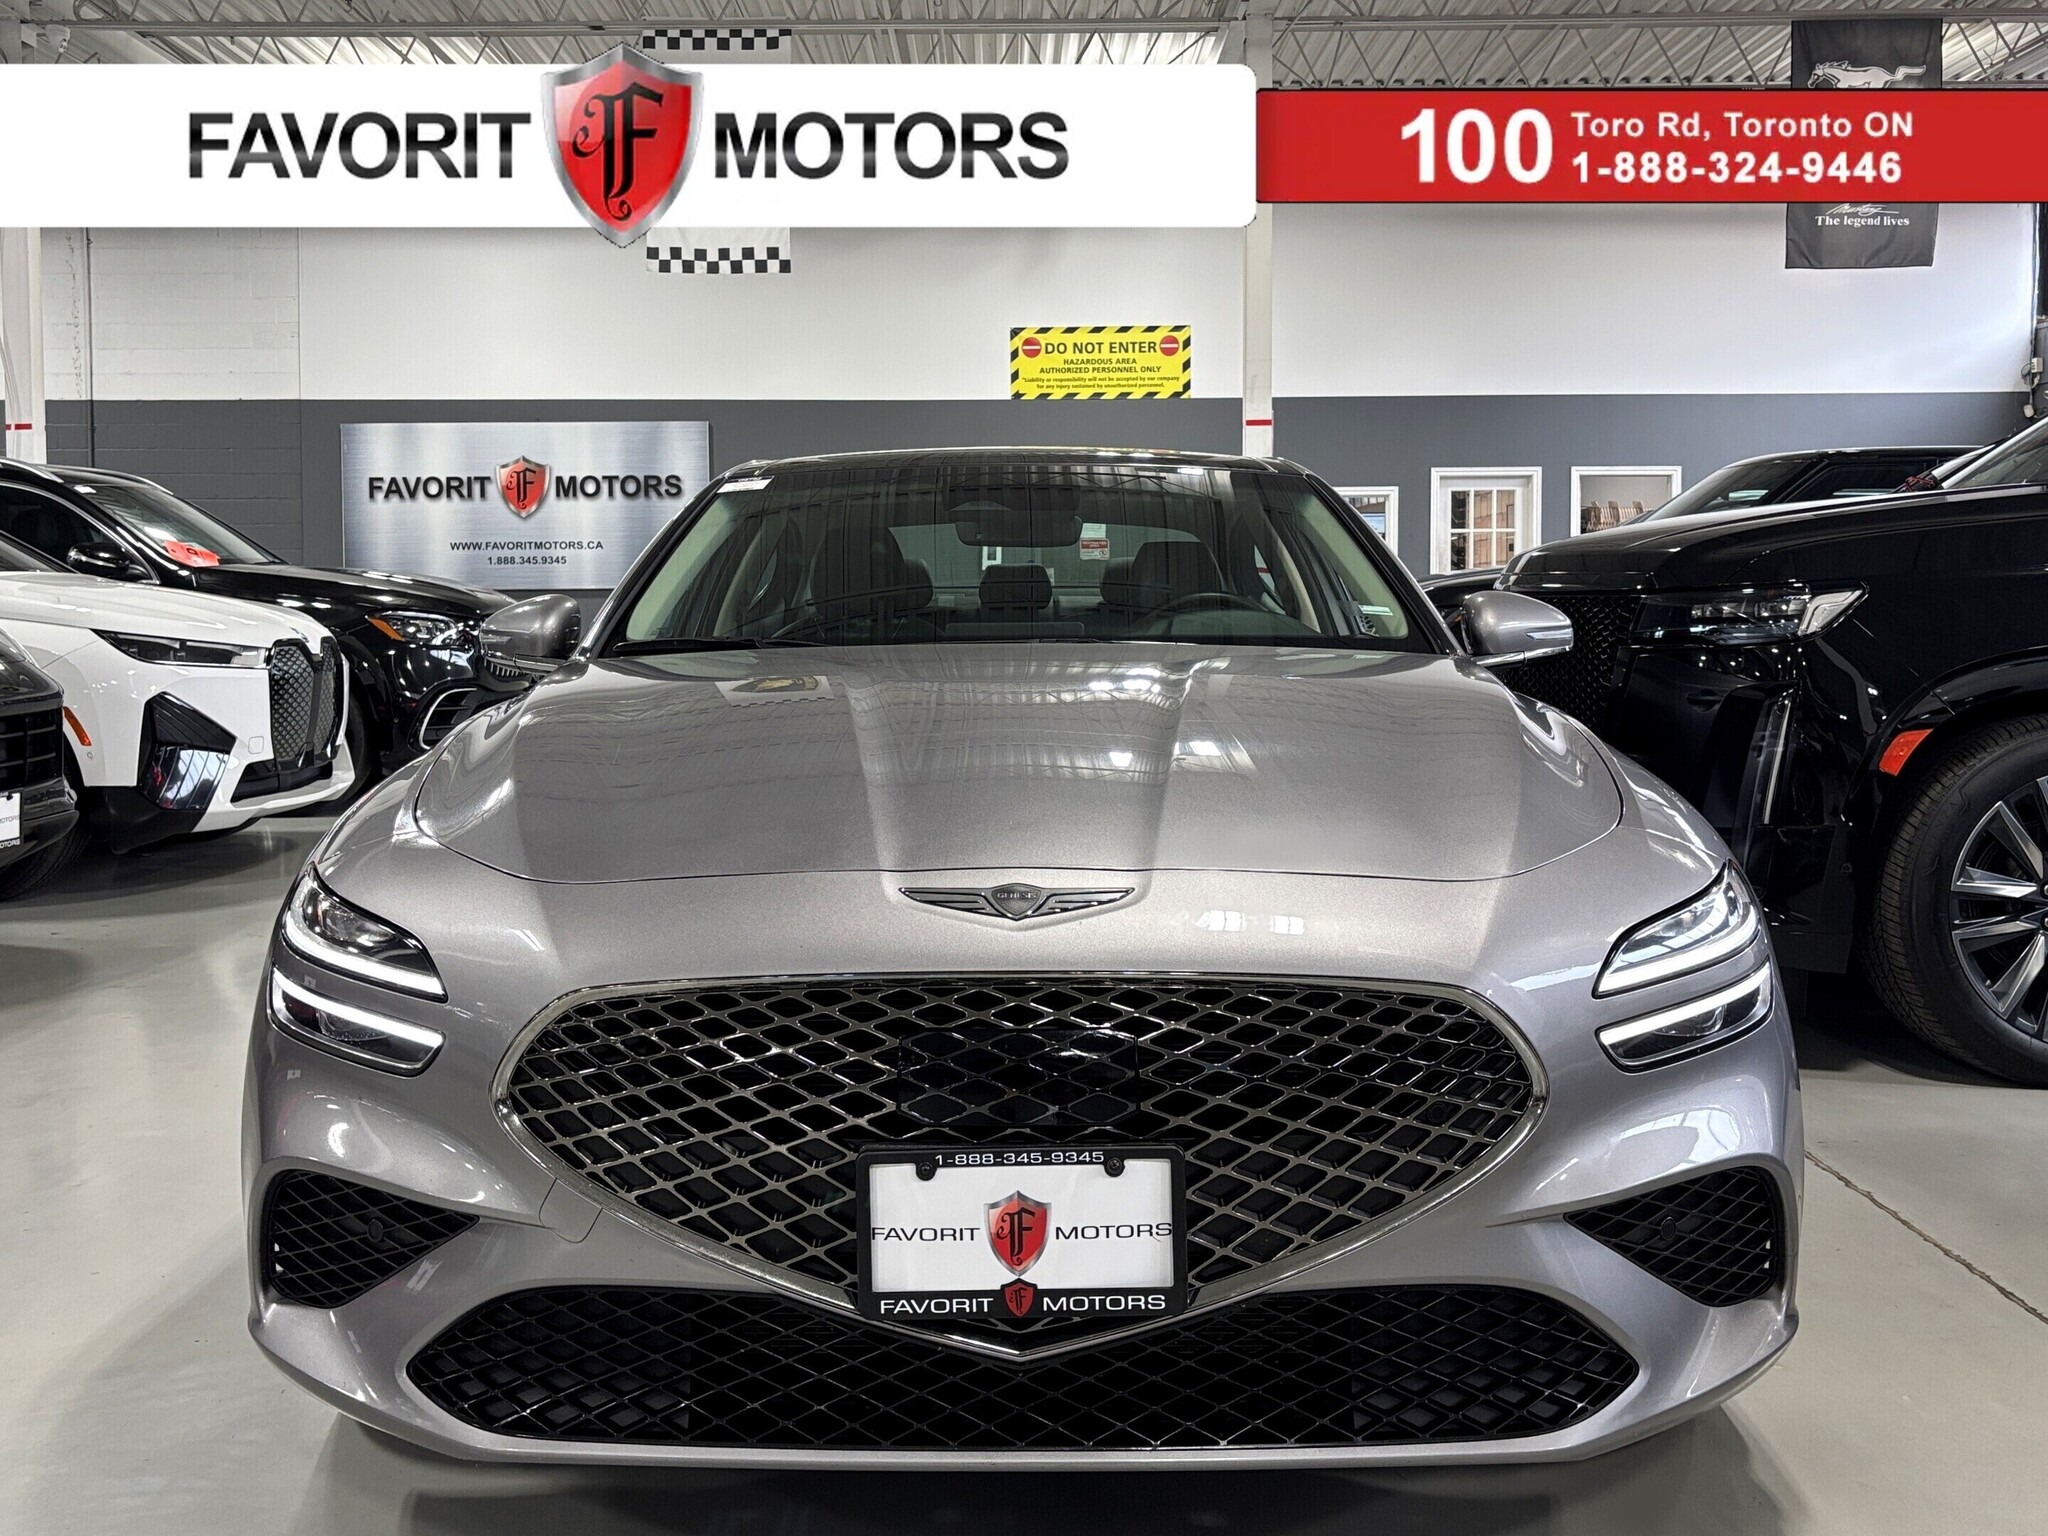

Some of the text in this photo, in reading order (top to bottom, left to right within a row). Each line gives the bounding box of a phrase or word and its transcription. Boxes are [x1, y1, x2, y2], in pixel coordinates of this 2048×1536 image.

[1815, 216, 1910, 228] The legend lives
[1044, 341, 1157, 354] DO NOT ENTER
[368, 476, 491, 500] FAVORIT
[555, 474, 683, 499] MOTORS
[450, 540, 604, 551] WWW.FAVORITMOTORS.CA
[488, 556, 567, 566] 1.888.345.9345
[0, 814, 20, 824] OTORS
[0, 838, 20, 848] OTORS
[934, 1152, 1104, 1166] 1-888-345-9345
[872, 1227, 980, 1242] FAVORIT
[1055, 1222, 1172, 1240] MOTORS
[880, 1298, 994, 1314] FAVORIT
[1042, 1295, 1166, 1312] MOTORS
